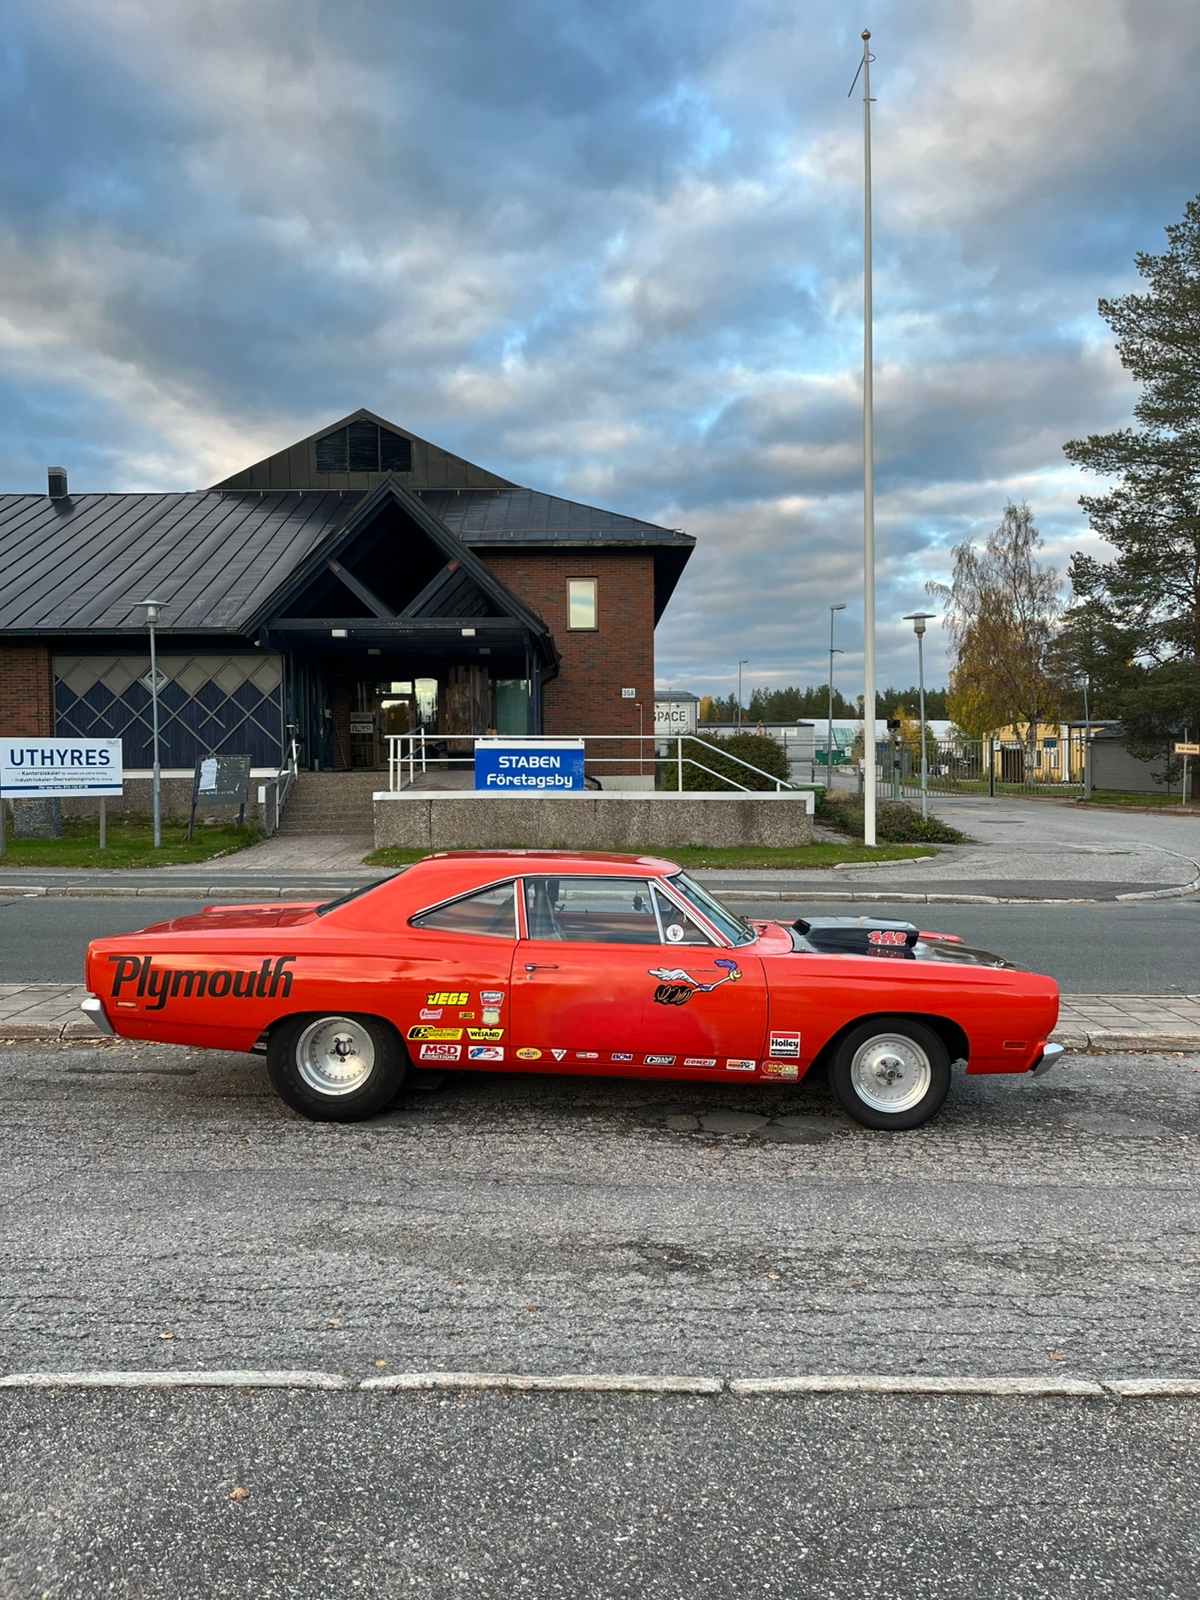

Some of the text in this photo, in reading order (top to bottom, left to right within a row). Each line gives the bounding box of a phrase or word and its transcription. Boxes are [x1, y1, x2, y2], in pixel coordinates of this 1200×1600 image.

[10, 748, 110, 766] UTHYRES
[498, 756, 560, 768] STABEN
[486, 774, 572, 788] Företagsby
[108, 956, 296, 1010] Plymouth
[427, 992, 470, 1005] JEGS
[425, 1045, 458, 1054] MSD
[771, 1039, 798, 1049] Holley
